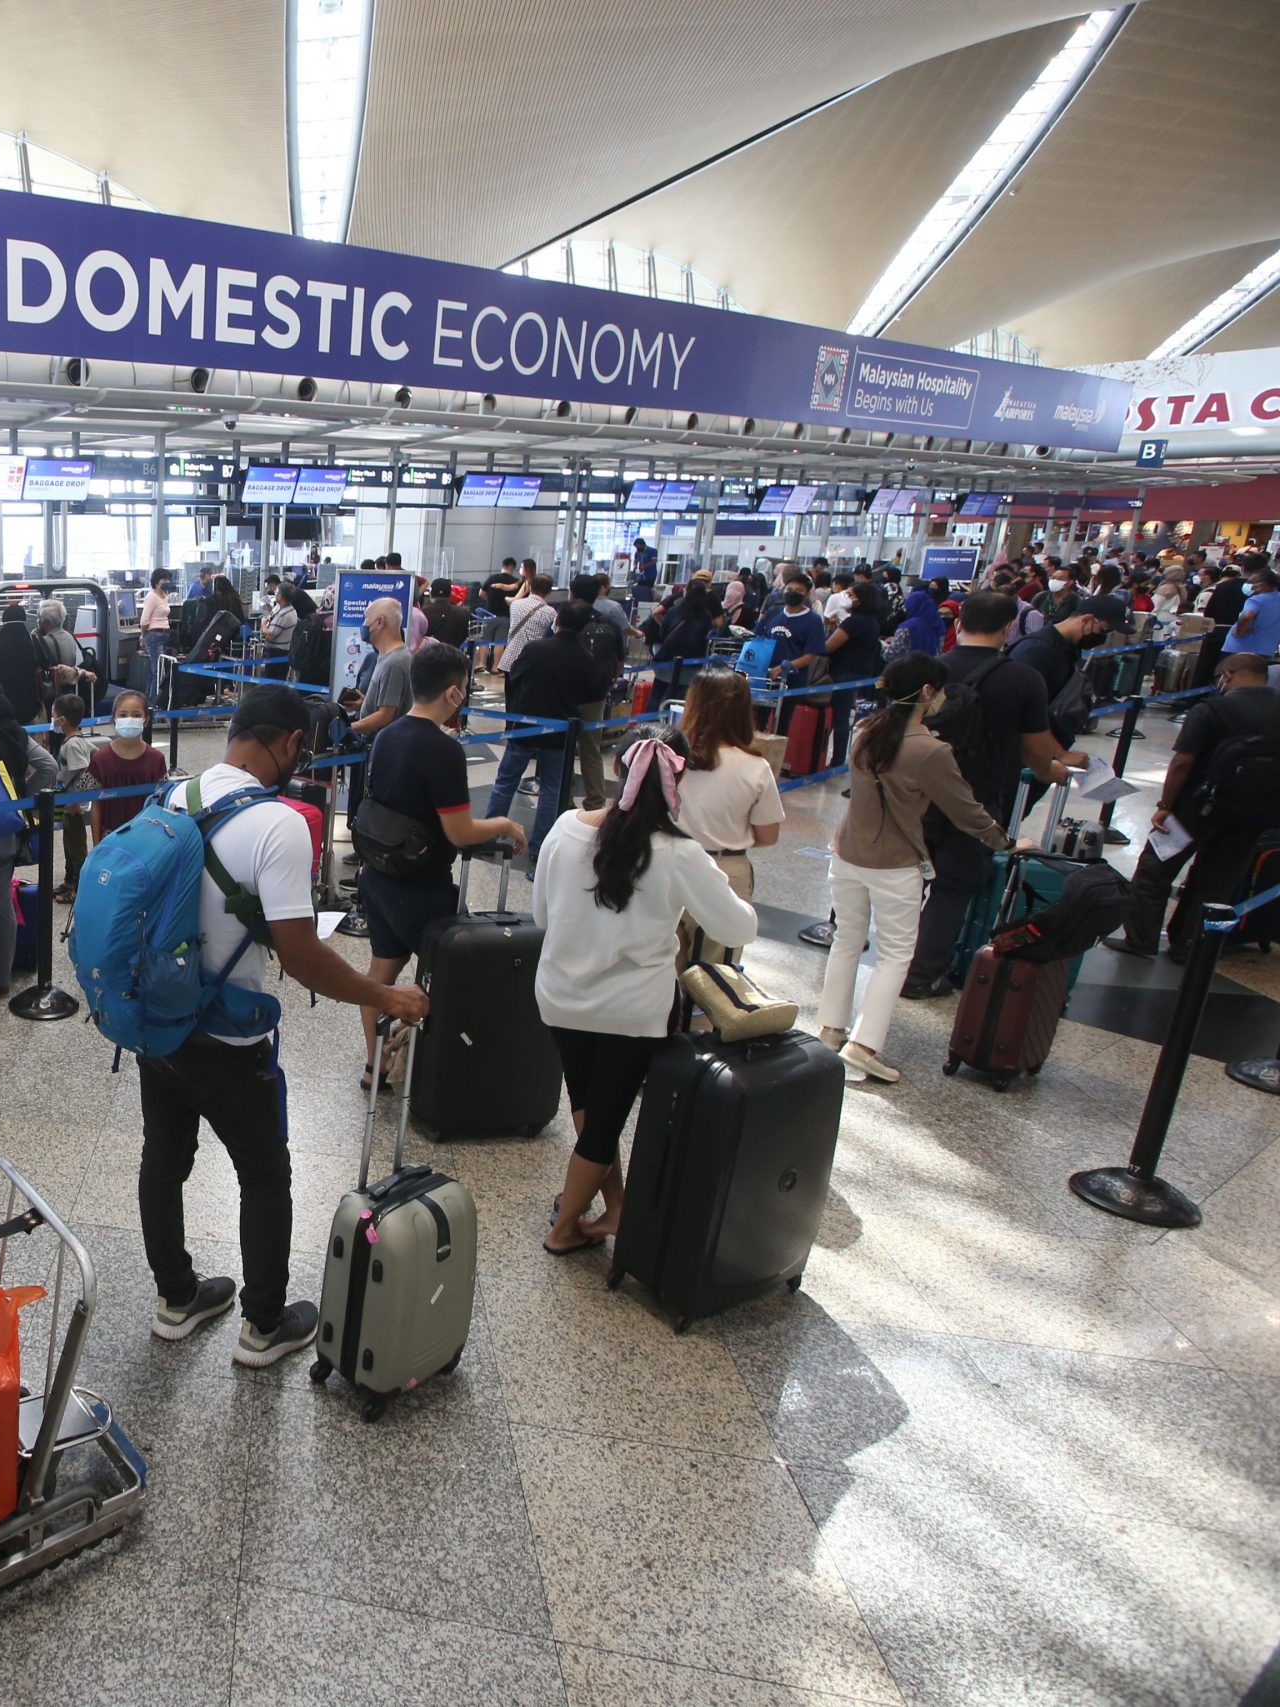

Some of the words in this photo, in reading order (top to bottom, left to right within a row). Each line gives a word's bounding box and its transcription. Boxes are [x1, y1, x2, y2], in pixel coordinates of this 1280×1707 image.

[6, 238, 413, 361] DOMESTIC
[432, 299, 697, 391] ECONOMY
[823, 373, 836, 386] MH
[858, 362, 915, 390] Malaysian
[915, 371, 973, 400] Hospitality
[854, 388, 892, 413] Begins
[895, 394, 919, 415] with
[920, 397, 934, 417] Us
[1005, 407, 1034, 421] AIRPORTS
[1125, 392, 1231, 432] STA
[1141, 443, 1157, 460] B
[142, 462, 157, 476] B6
[221, 464, 235, 478] B7
[29, 479, 65, 487] BAGGAGE
[381, 470, 393, 483] B8
[441, 472, 453, 485] B9
[247, 484, 275, 492] BAGGAGE
